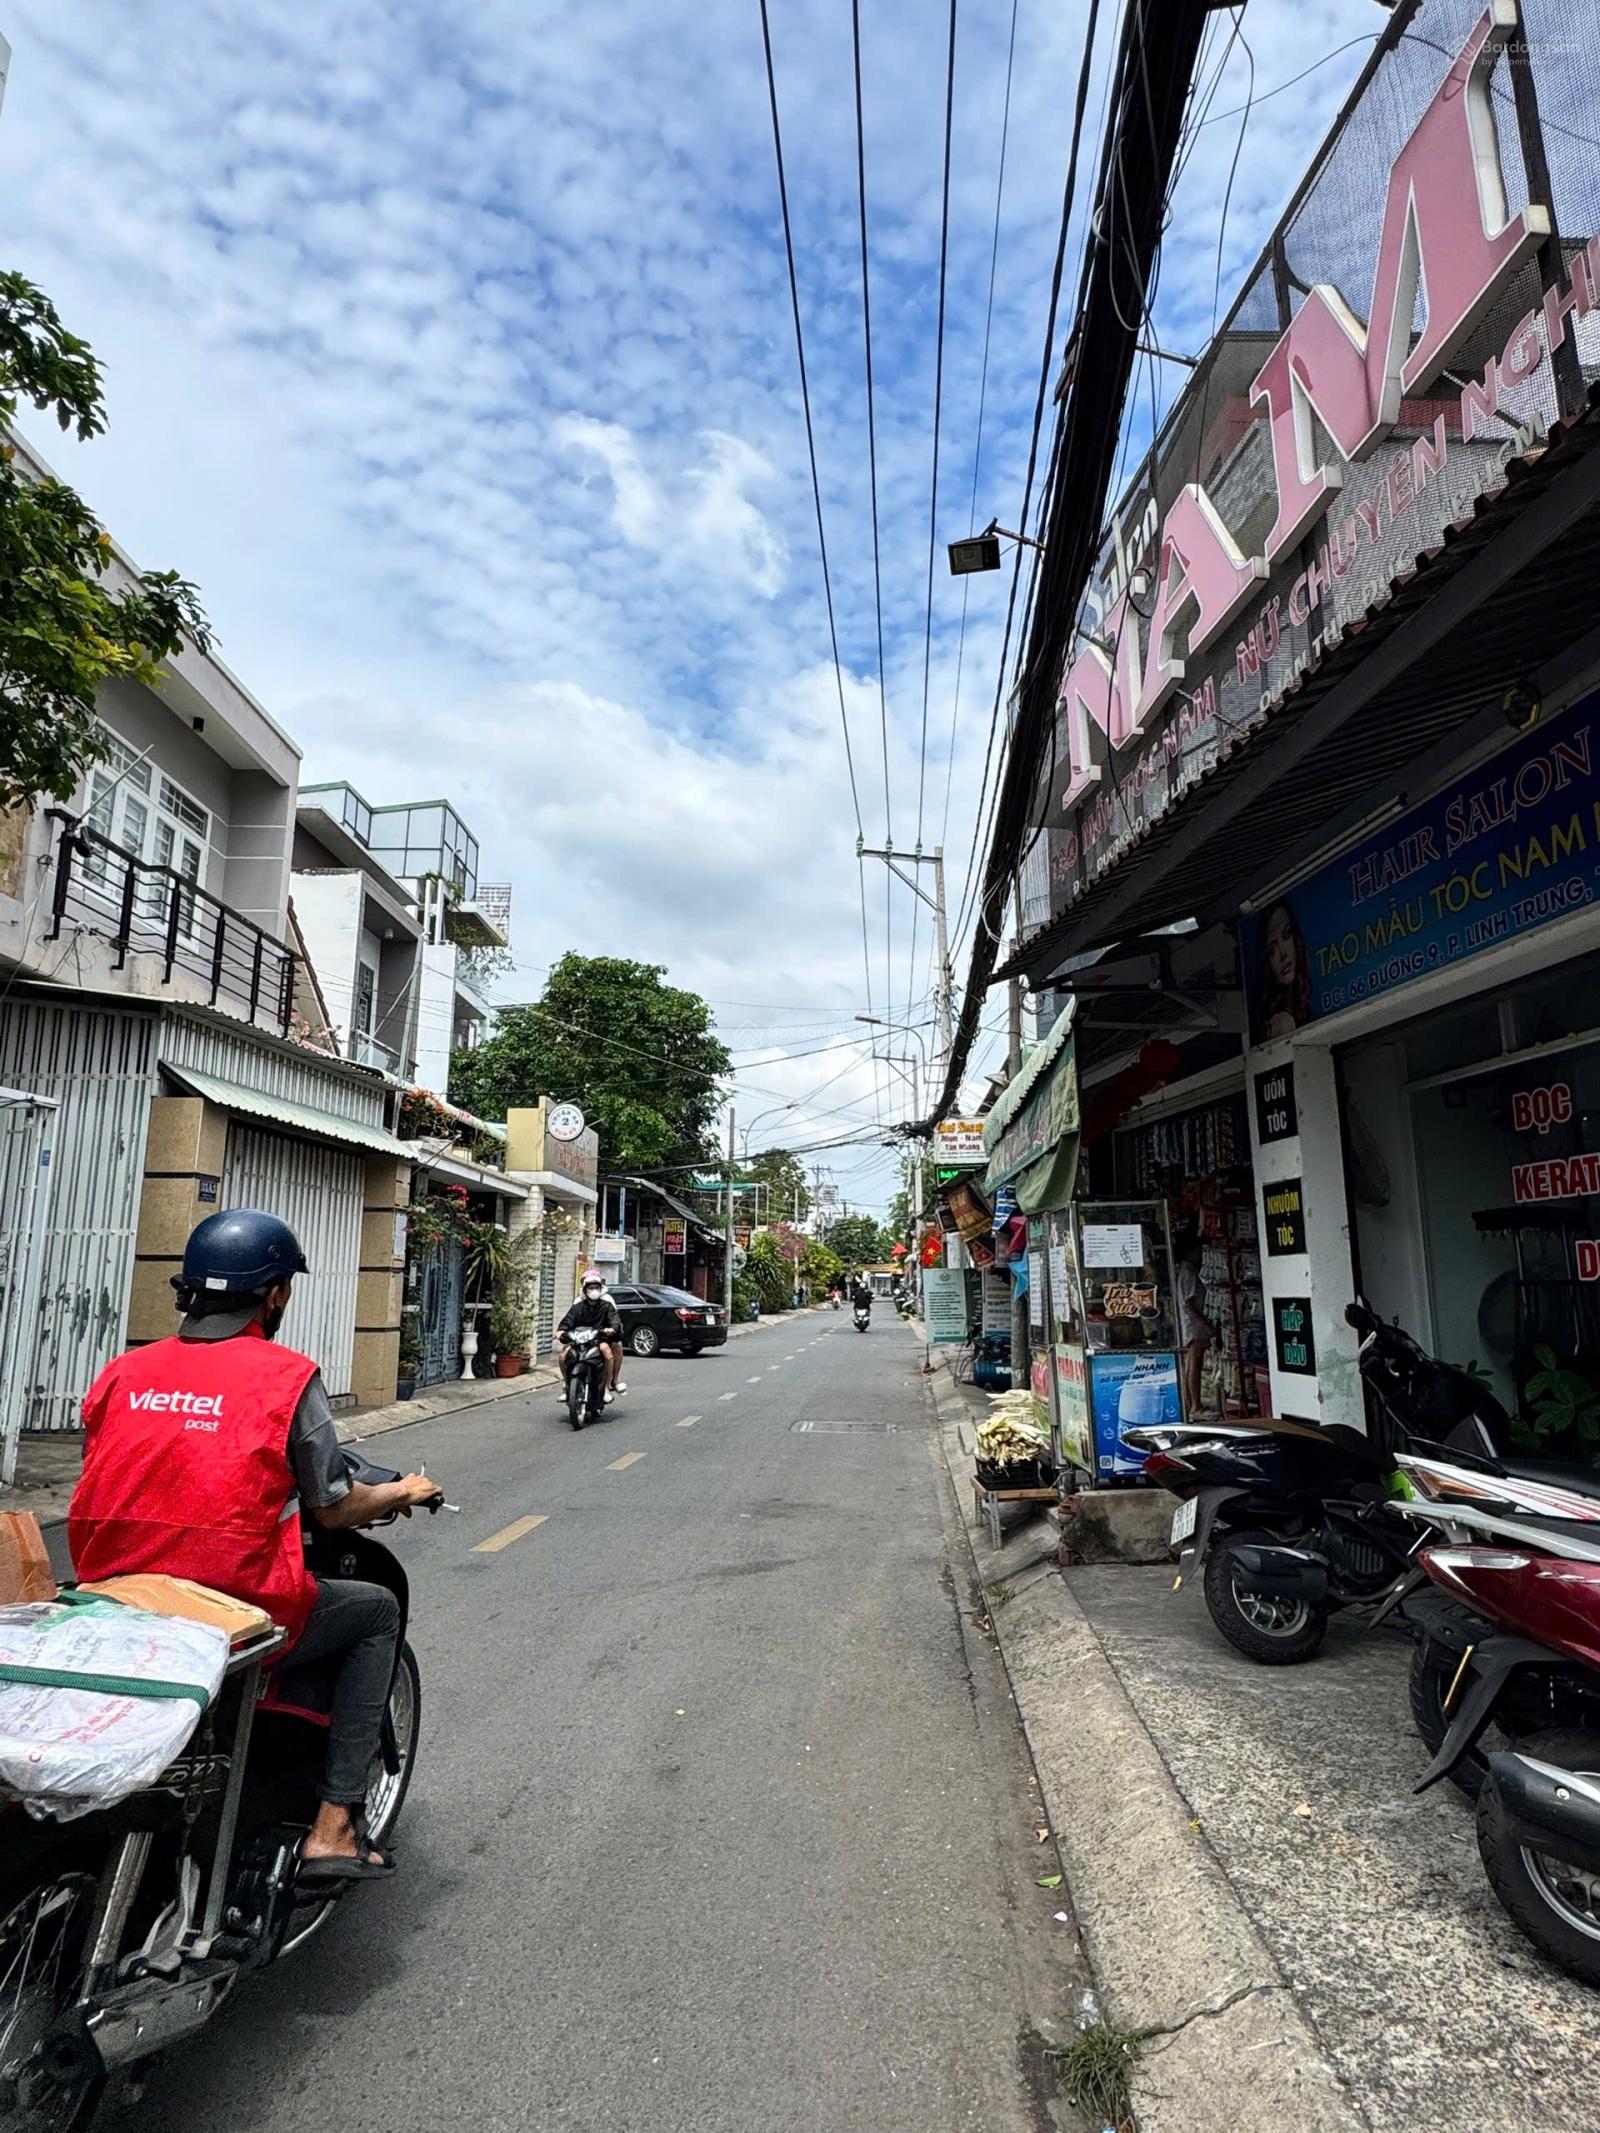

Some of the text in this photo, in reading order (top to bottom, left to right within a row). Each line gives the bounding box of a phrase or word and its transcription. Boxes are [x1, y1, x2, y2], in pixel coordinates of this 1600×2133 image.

[1060, 0, 1550, 812] NAM
[1162, 675, 1216, 765] NAM
[1235, 594, 1280, 686] NỮ
[1348, 725, 1592, 907] HAIR SALON
[1315, 931, 1361, 977] TẠO
[1364, 895, 1425, 955] MẪU
[1429, 861, 1494, 921] TÓC
[1497, 812, 1587, 890] NAM
[1349, 976, 1366, 998] 66
[1465, 914, 1509, 951] LINH
[1512, 875, 1593, 927] TRUNG,
[562, 1117, 569, 1125] 2
[1266, 1109, 1288, 1133] TÓC
[1512, 1082, 1573, 1134] BỌC
[1267, 1190, 1300, 1217] NHUỘM
[1276, 1223, 1295, 1248] TÓC
[1134, 1362, 1170, 1373] NHANH
[129, 1388, 224, 1417] viettel
[184, 1419, 219, 1432] post
